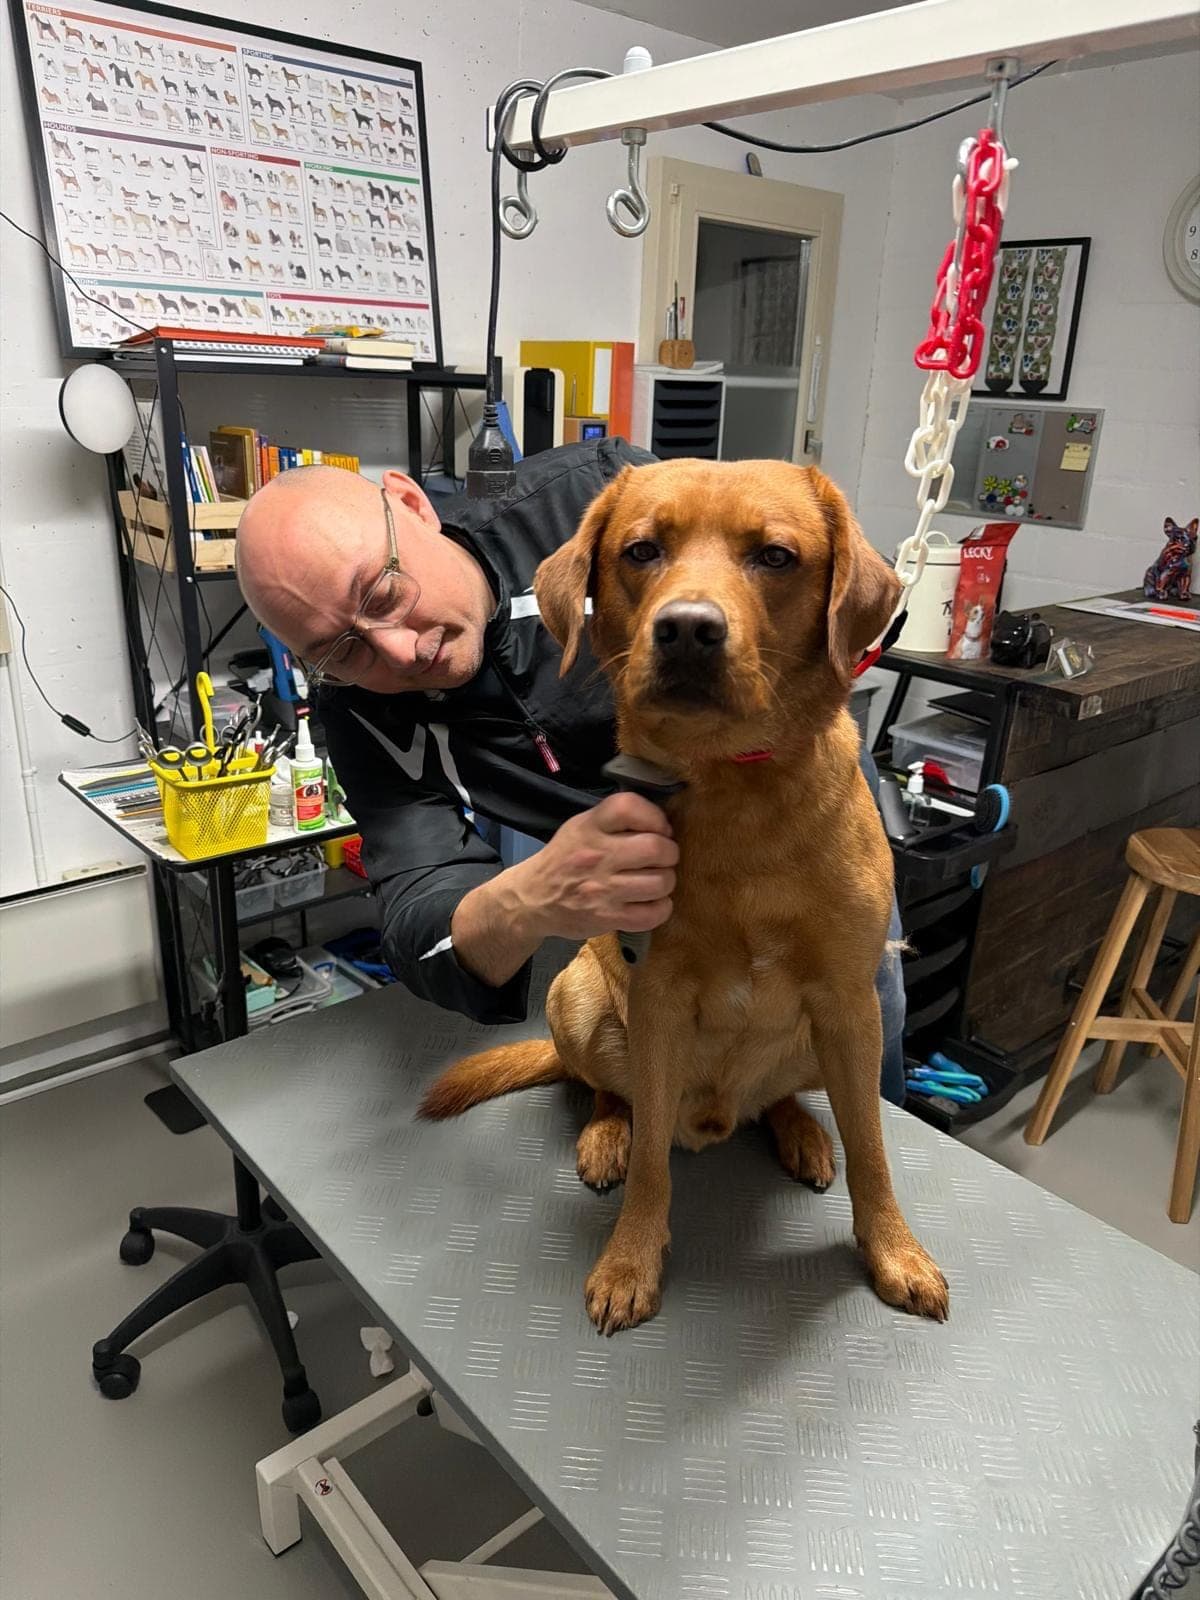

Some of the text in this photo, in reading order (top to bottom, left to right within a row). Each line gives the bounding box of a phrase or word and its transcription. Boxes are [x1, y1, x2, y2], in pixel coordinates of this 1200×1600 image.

[26, 2, 62, 16] TERRIERS
[242, 48, 275, 60] SPORTING
[44, 121, 77, 133] HOUNDS
[211, 147, 259, 160] NON-SPORTING
[305, 162, 333, 172] WORKING
[1188, 225, 1197, 237] 9
[1190, 248, 1199, 260] 8
[963, 546, 994, 560] LECKY
